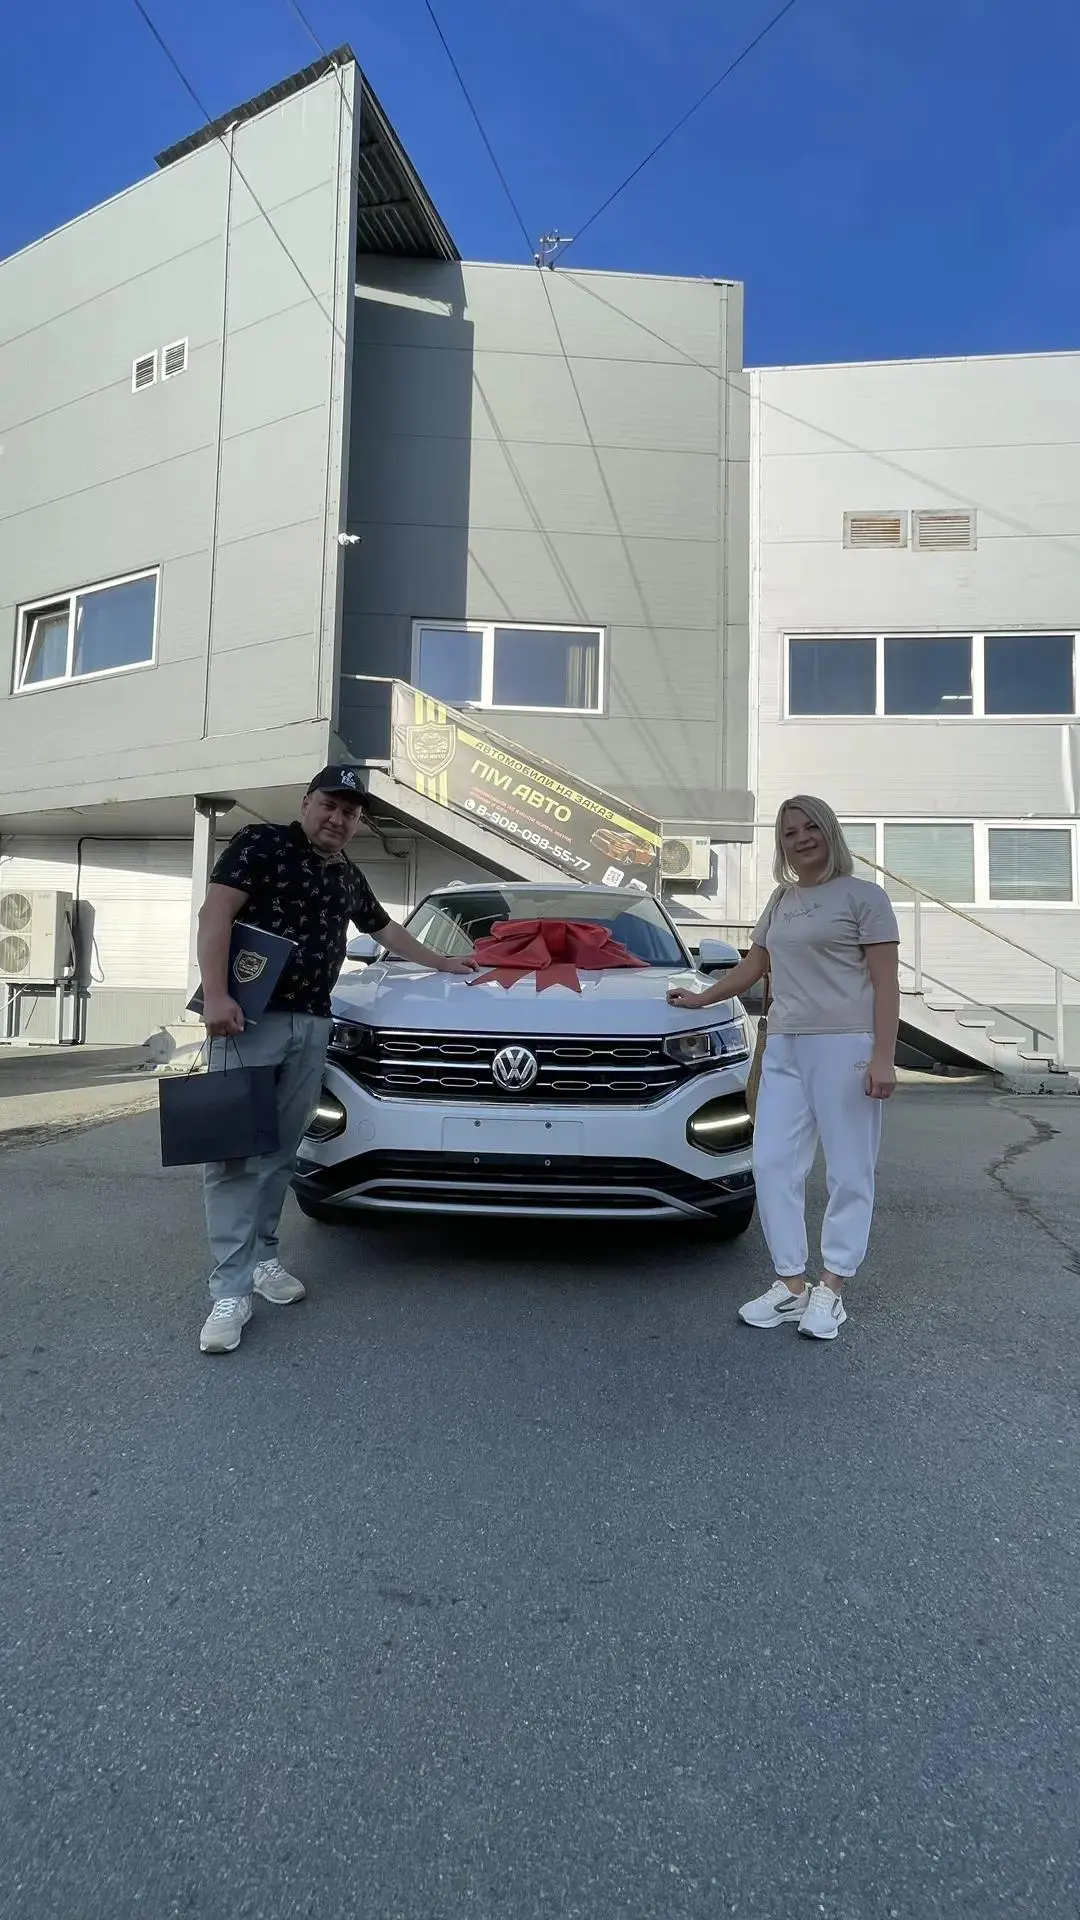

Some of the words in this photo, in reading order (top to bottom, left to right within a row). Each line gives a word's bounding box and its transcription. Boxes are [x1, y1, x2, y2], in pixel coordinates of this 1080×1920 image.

[470, 759, 513, 791] ПМ
[511, 784, 572, 822] АВТО
[475, 742, 554, 787] АВТОМОБИЛИ
[556, 785, 573, 798] НА
[574, 795, 614, 820] ЗАКАЗ
[476, 804, 592, 871] 8-908-098-55-77
